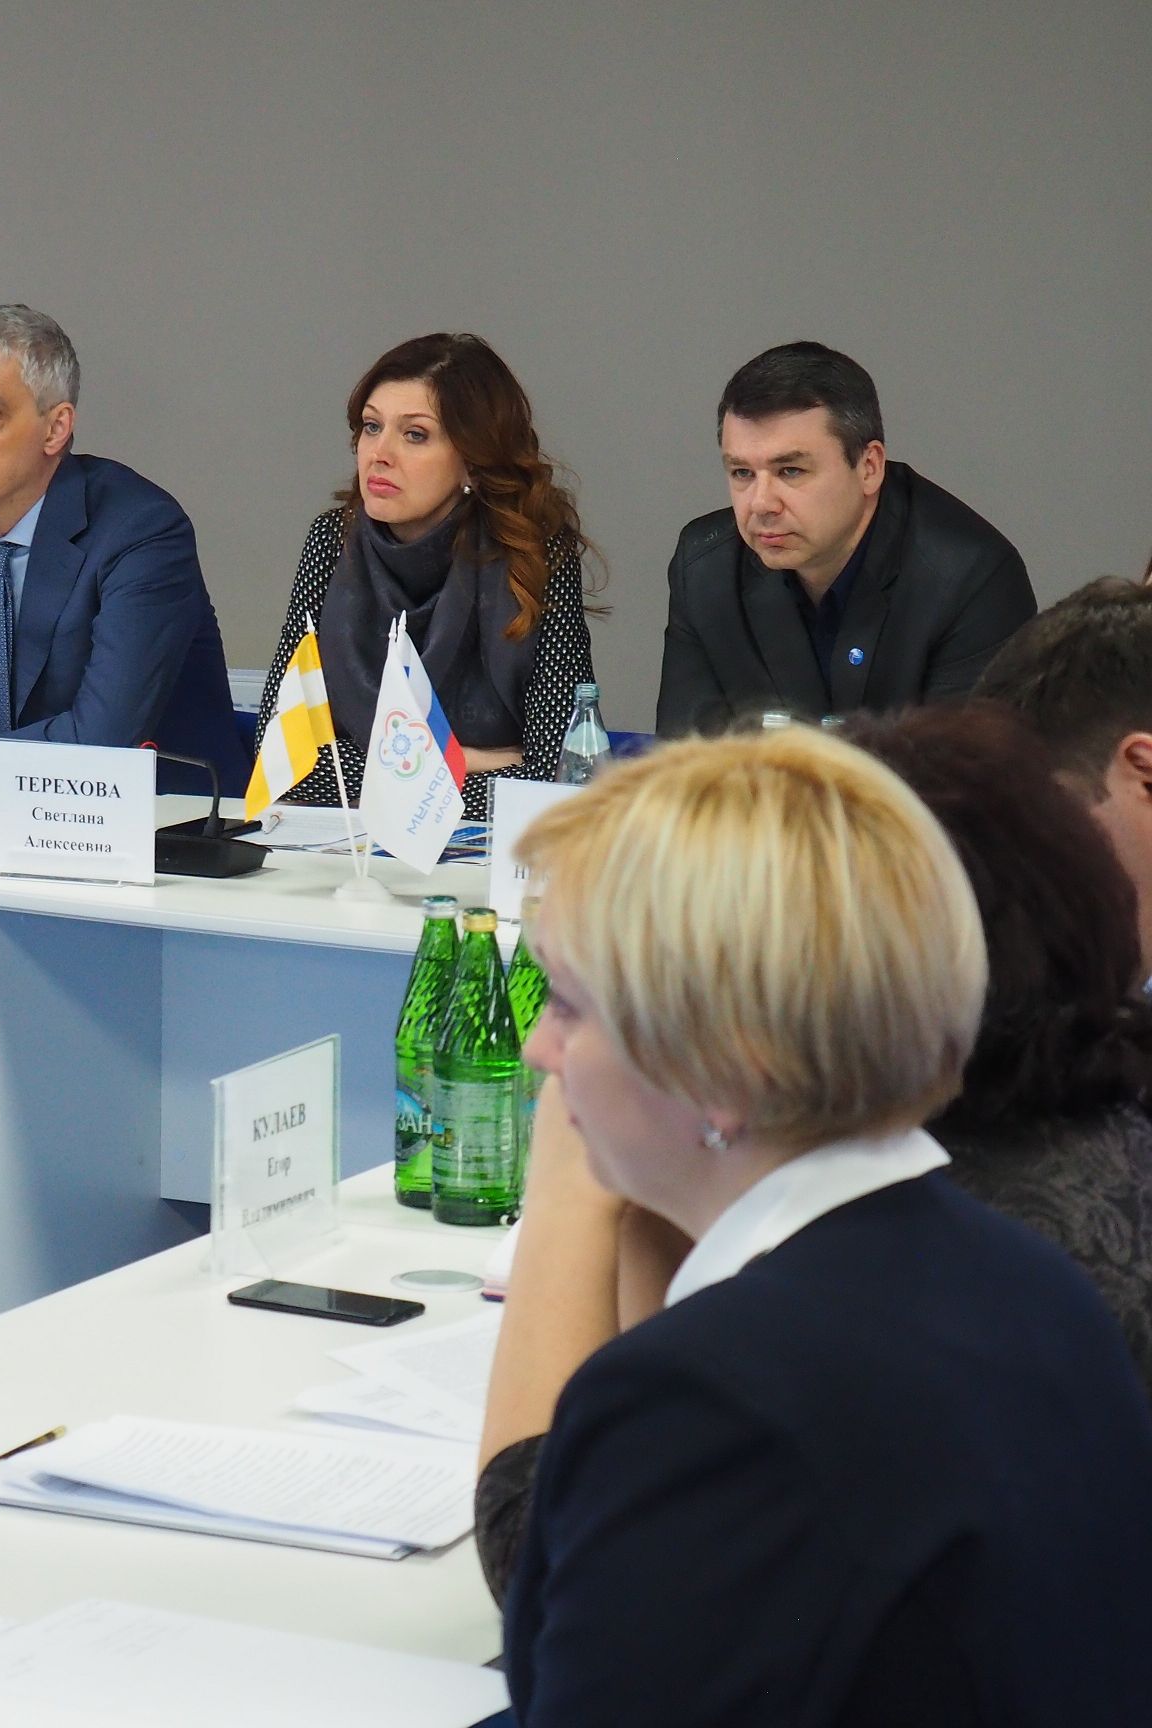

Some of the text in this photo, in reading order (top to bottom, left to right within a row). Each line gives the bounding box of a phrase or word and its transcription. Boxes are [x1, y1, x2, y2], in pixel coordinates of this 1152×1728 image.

[15, 775, 121, 799] ТЕРЕХОВА
[32, 806, 104, 825] Светлана
[24, 834, 112, 853] Алексеевна
[253, 1103, 306, 1141] КУЛАЕВ
